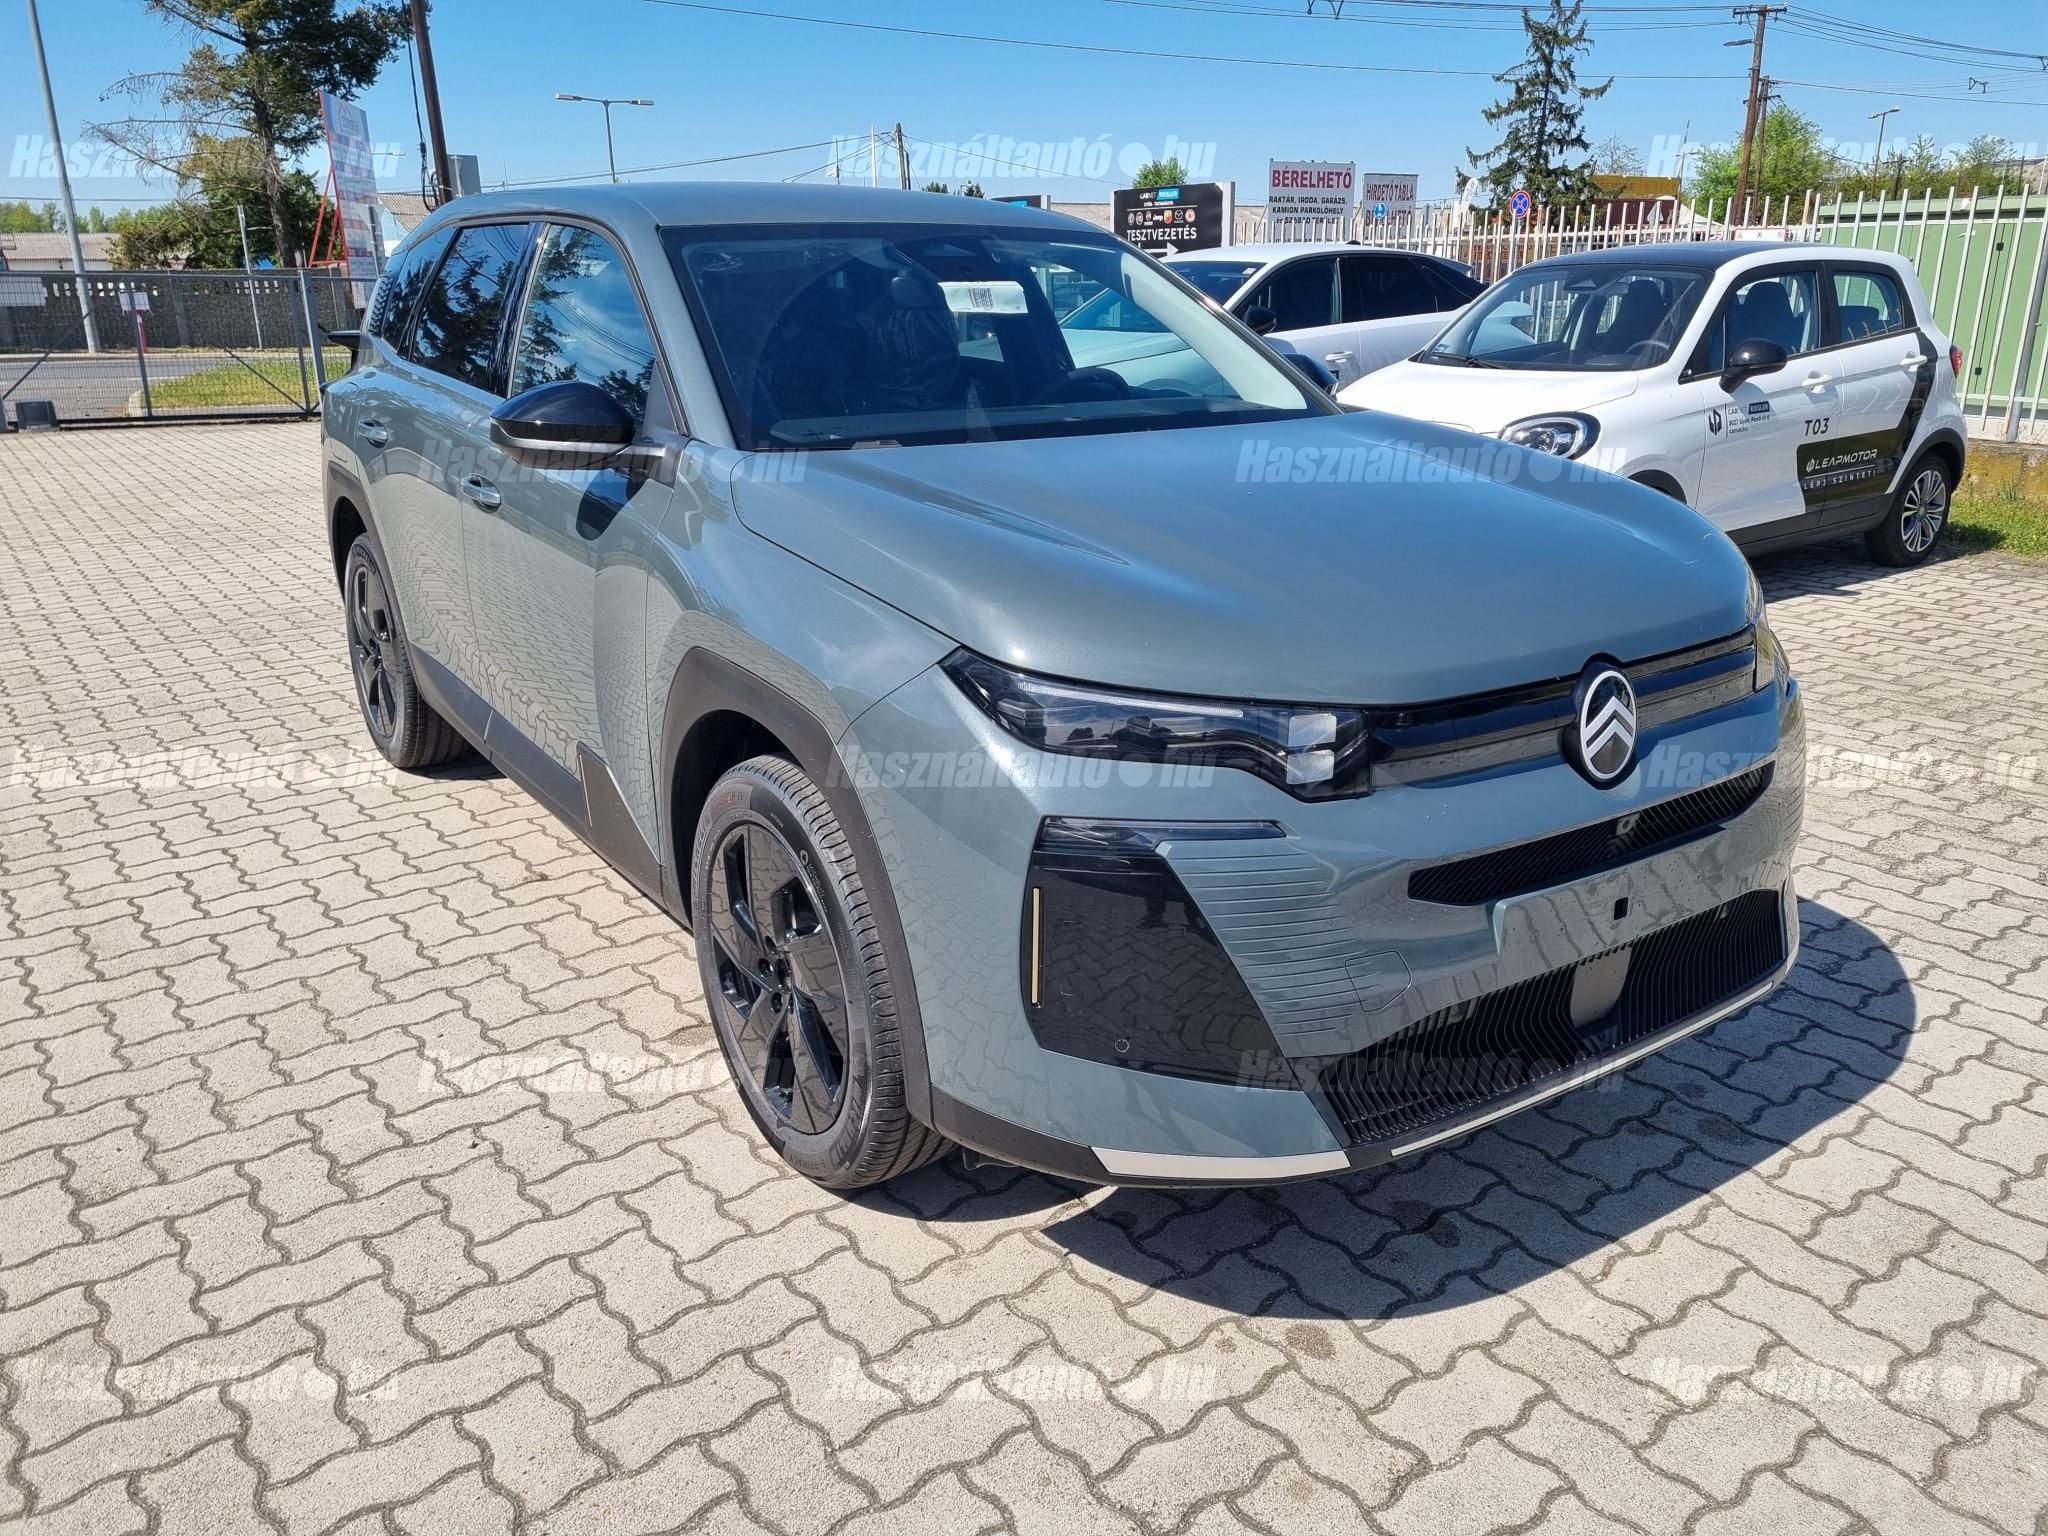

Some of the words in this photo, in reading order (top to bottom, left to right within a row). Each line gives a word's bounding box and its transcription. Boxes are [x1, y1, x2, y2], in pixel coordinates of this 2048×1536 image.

[1272, 166, 1352, 189] BÉRELHETŐ
[1269, 195, 1297, 204] RAKTÁR,
[1298, 196, 1319, 205] IRODA,
[1272, 206, 1298, 214] KAMION
[1300, 206, 1344, 215] PARKOLÓHELY
[1127, 224, 1197, 241] TESZTVEZETÉS
[1805, 417, 1830, 436] T03
[1815, 449, 1878, 469] LEAPMOTOR
[1804, 479, 1827, 489] LÉPJ
